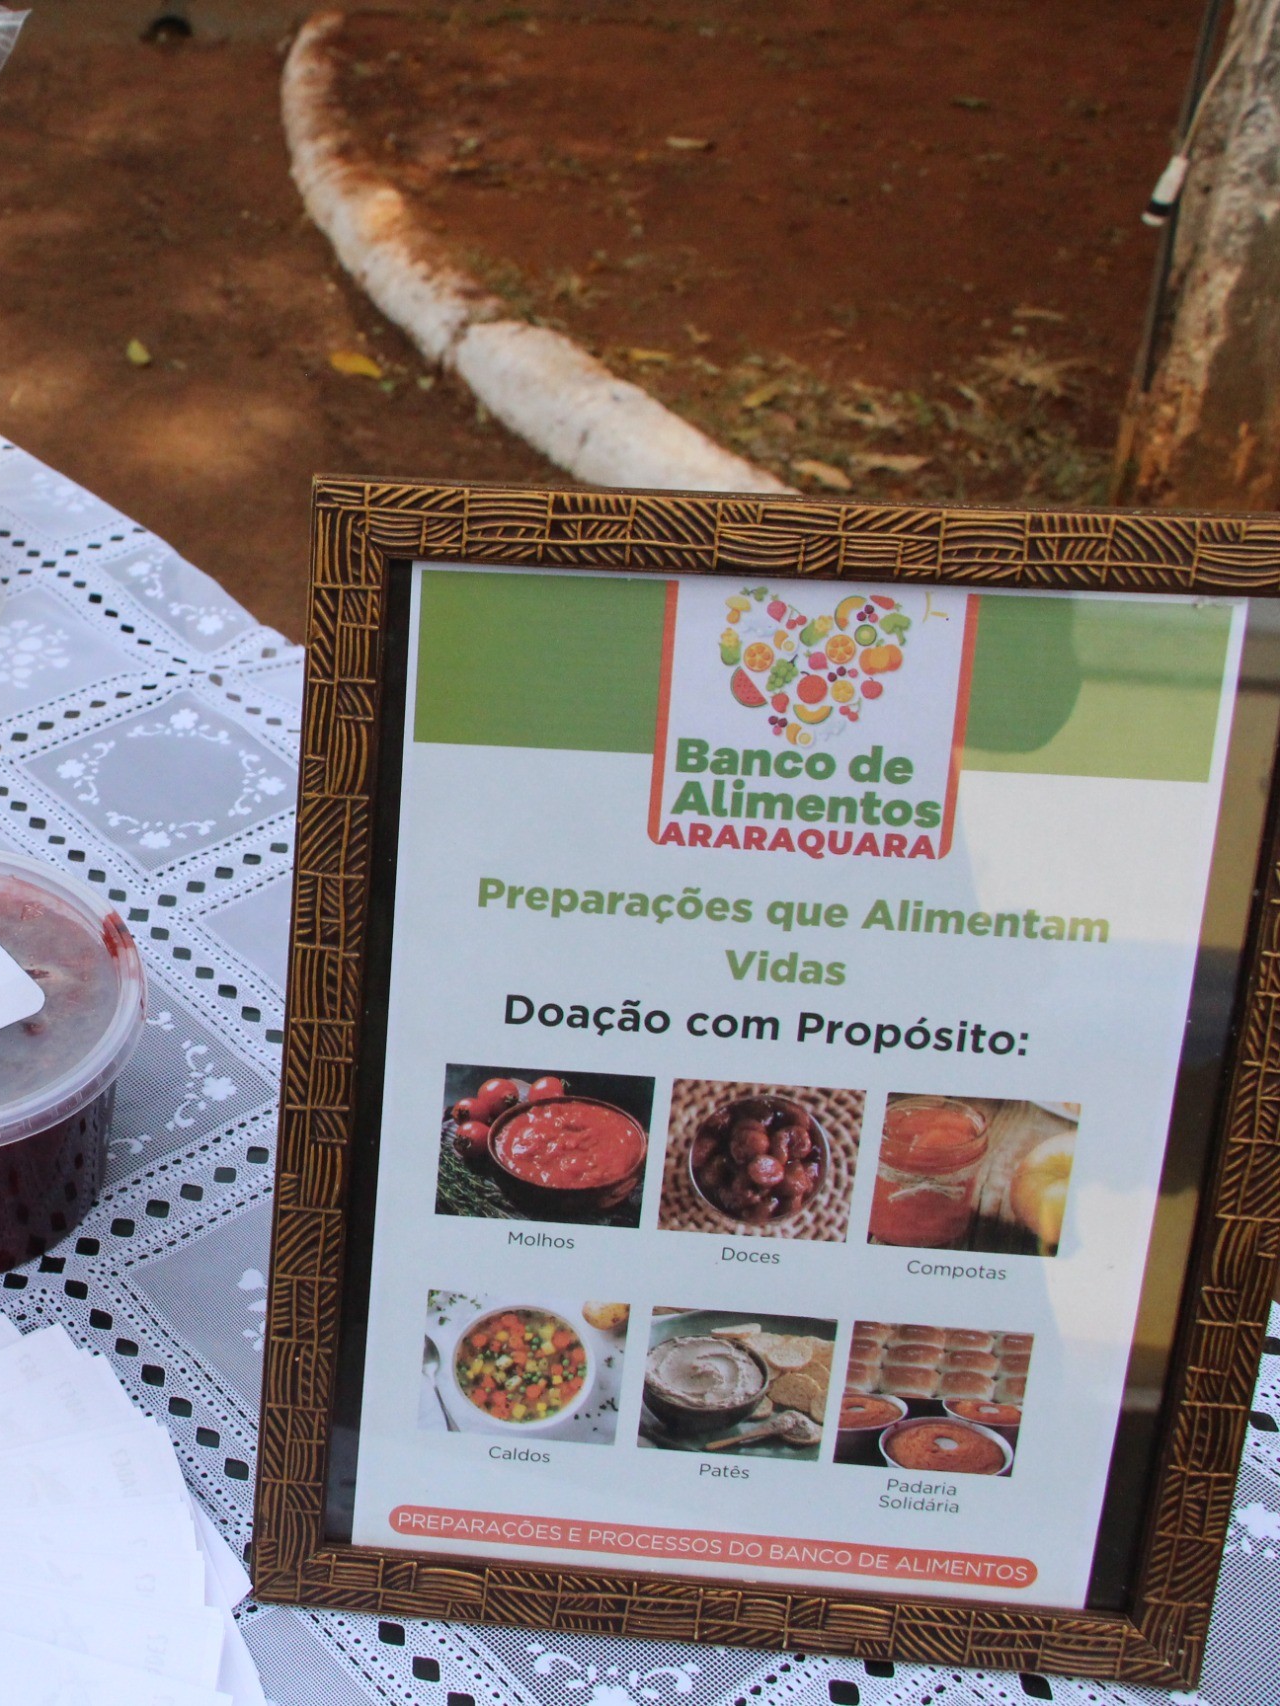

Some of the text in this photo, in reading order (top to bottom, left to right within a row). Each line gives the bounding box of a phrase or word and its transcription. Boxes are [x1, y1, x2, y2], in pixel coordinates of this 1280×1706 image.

[675, 738, 914, 785] Banco de
[670, 779, 942, 829] Alimentos
[658, 822, 936, 860] ARARAQUARA
[477, 878, 1110, 943] Preparações que Alimentam
[725, 950, 846, 986] Vidas
[504, 994, 1030, 1056] Doação com Propósito:
[507, 1231, 576, 1249] Molhos
[721, 1246, 781, 1265] Doces
[906, 1260, 1007, 1281] Compotas
[488, 1445, 551, 1464] Caldos
[699, 1463, 750, 1481] Patês
[886, 1478, 958, 1497] Padaria
[878, 1494, 960, 1515] Solidária
[397, 1511, 1028, 1582] PREPARAÇÕES E PROCESSOS DO BANCO DE ALIMENTOS
